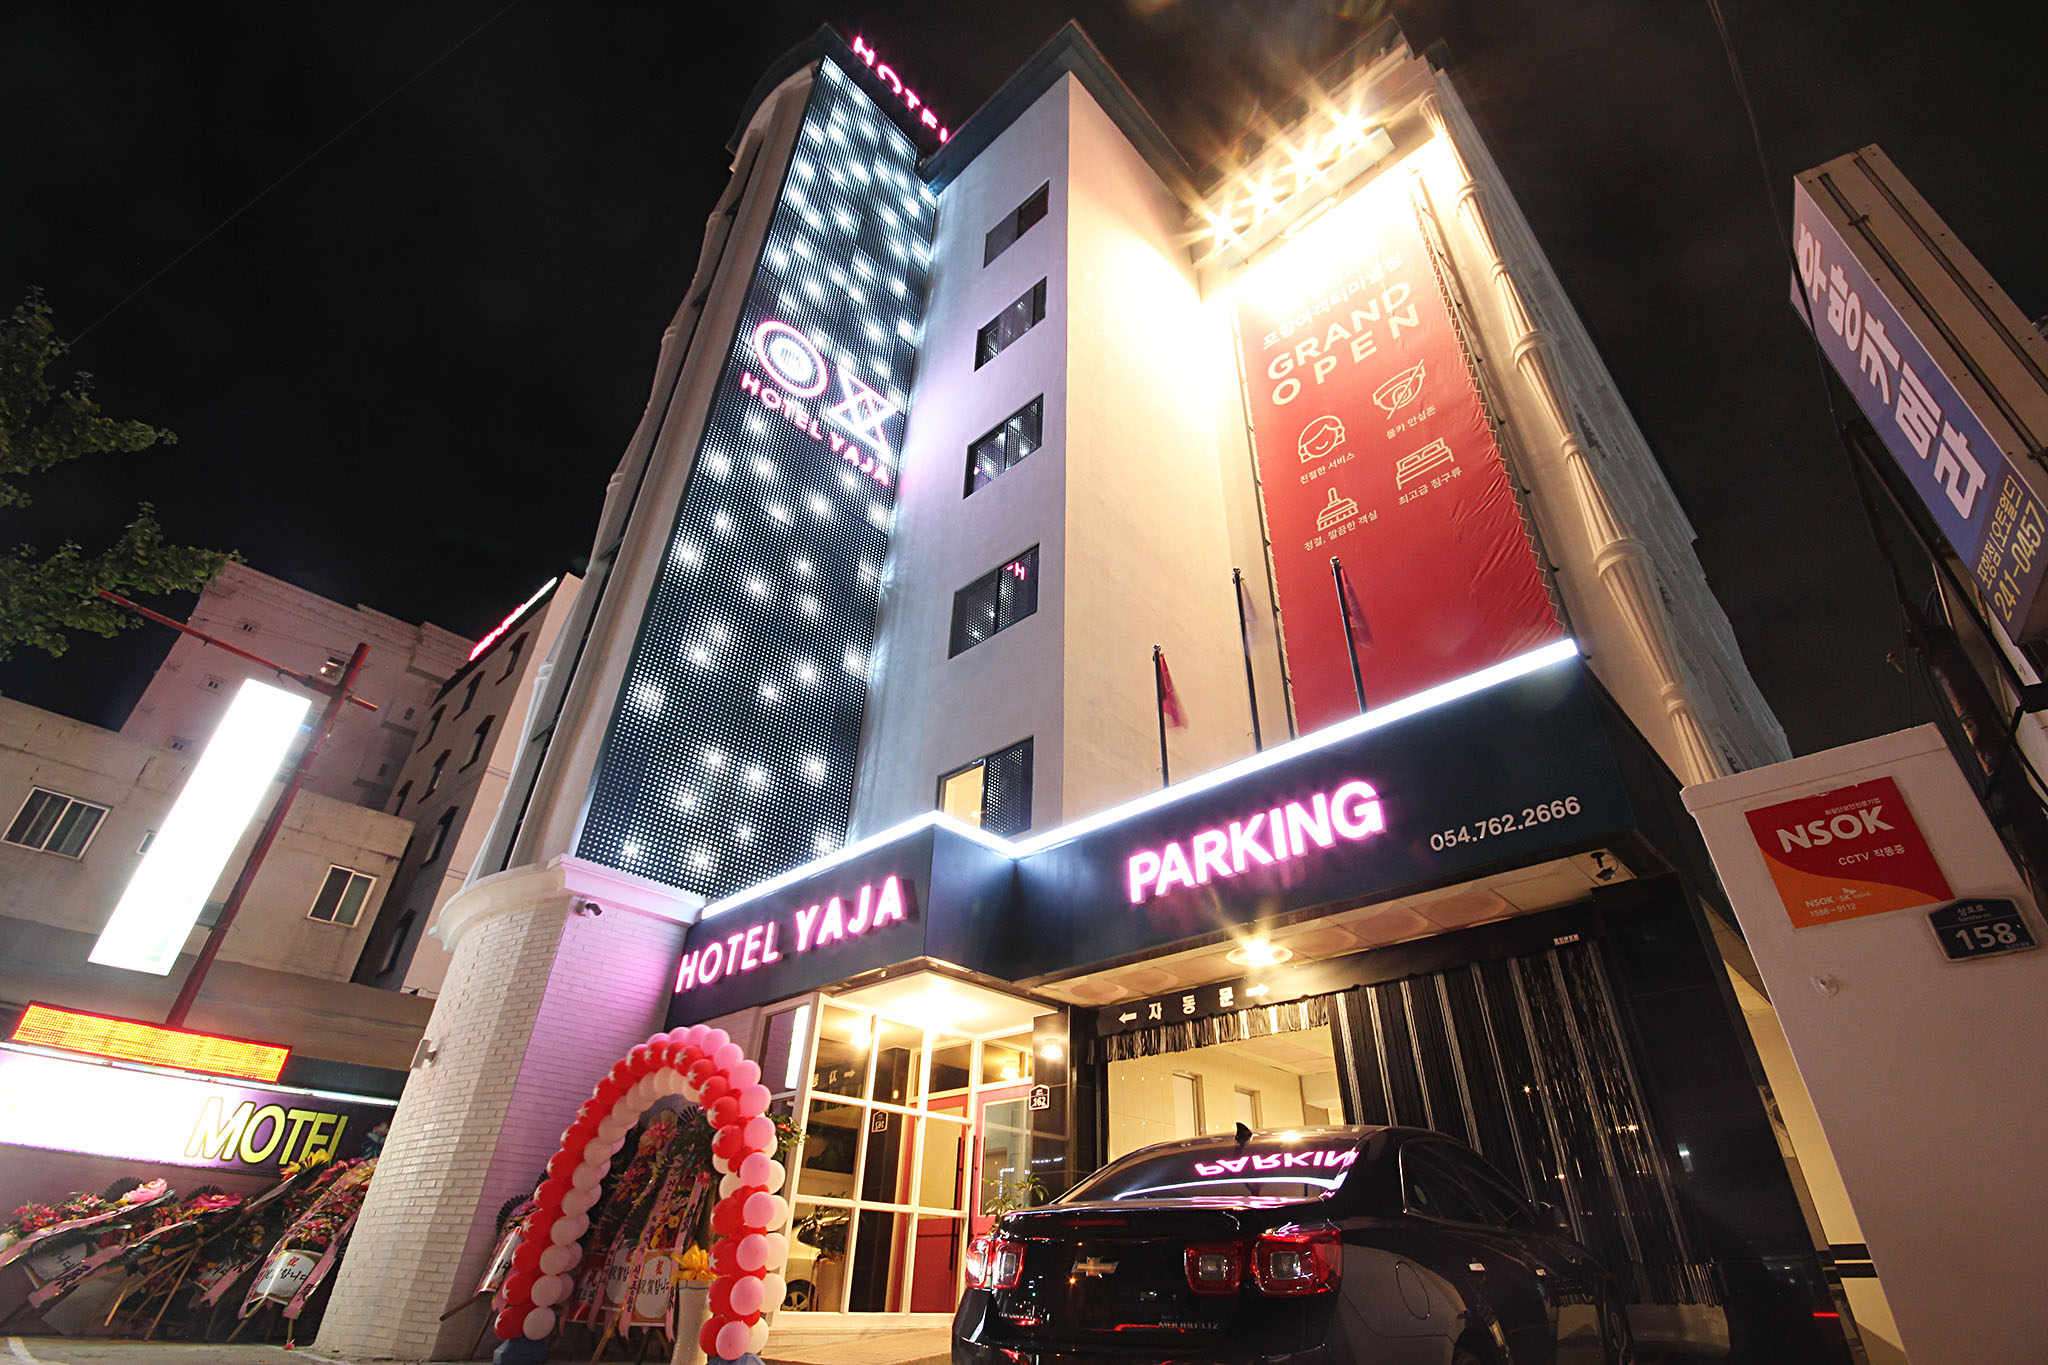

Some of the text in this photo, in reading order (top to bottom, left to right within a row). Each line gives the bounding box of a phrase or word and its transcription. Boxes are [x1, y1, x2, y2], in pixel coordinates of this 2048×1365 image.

[1267, 282, 1411, 381] GRAND
[1271, 303, 1421, 407] OPEN
[1797, 221, 1987, 520] 후방카메라
[740, 371, 890, 486] HOTEL YAJA
[1300, 452, 1356, 485] 친절한 서비스
[1398, 466, 1463, 506] 최고급 침구류
[1328, 521, 1356, 542] 깔끔한
[1358, 510, 1379, 528] 객실
[1994, 500, 2046, 623] 241-0457
[1129, 780, 1387, 905] PARKING
[1430, 796, 1581, 853] 054.762.2666
[1776, 806, 1895, 854] NSOK
[1838, 852, 1870, 866] CCTV
[674, 875, 905, 994] HOTEL YAJA
[1955, 922, 2017, 951] 158
[1031, 1096, 1047, 1107] 162
